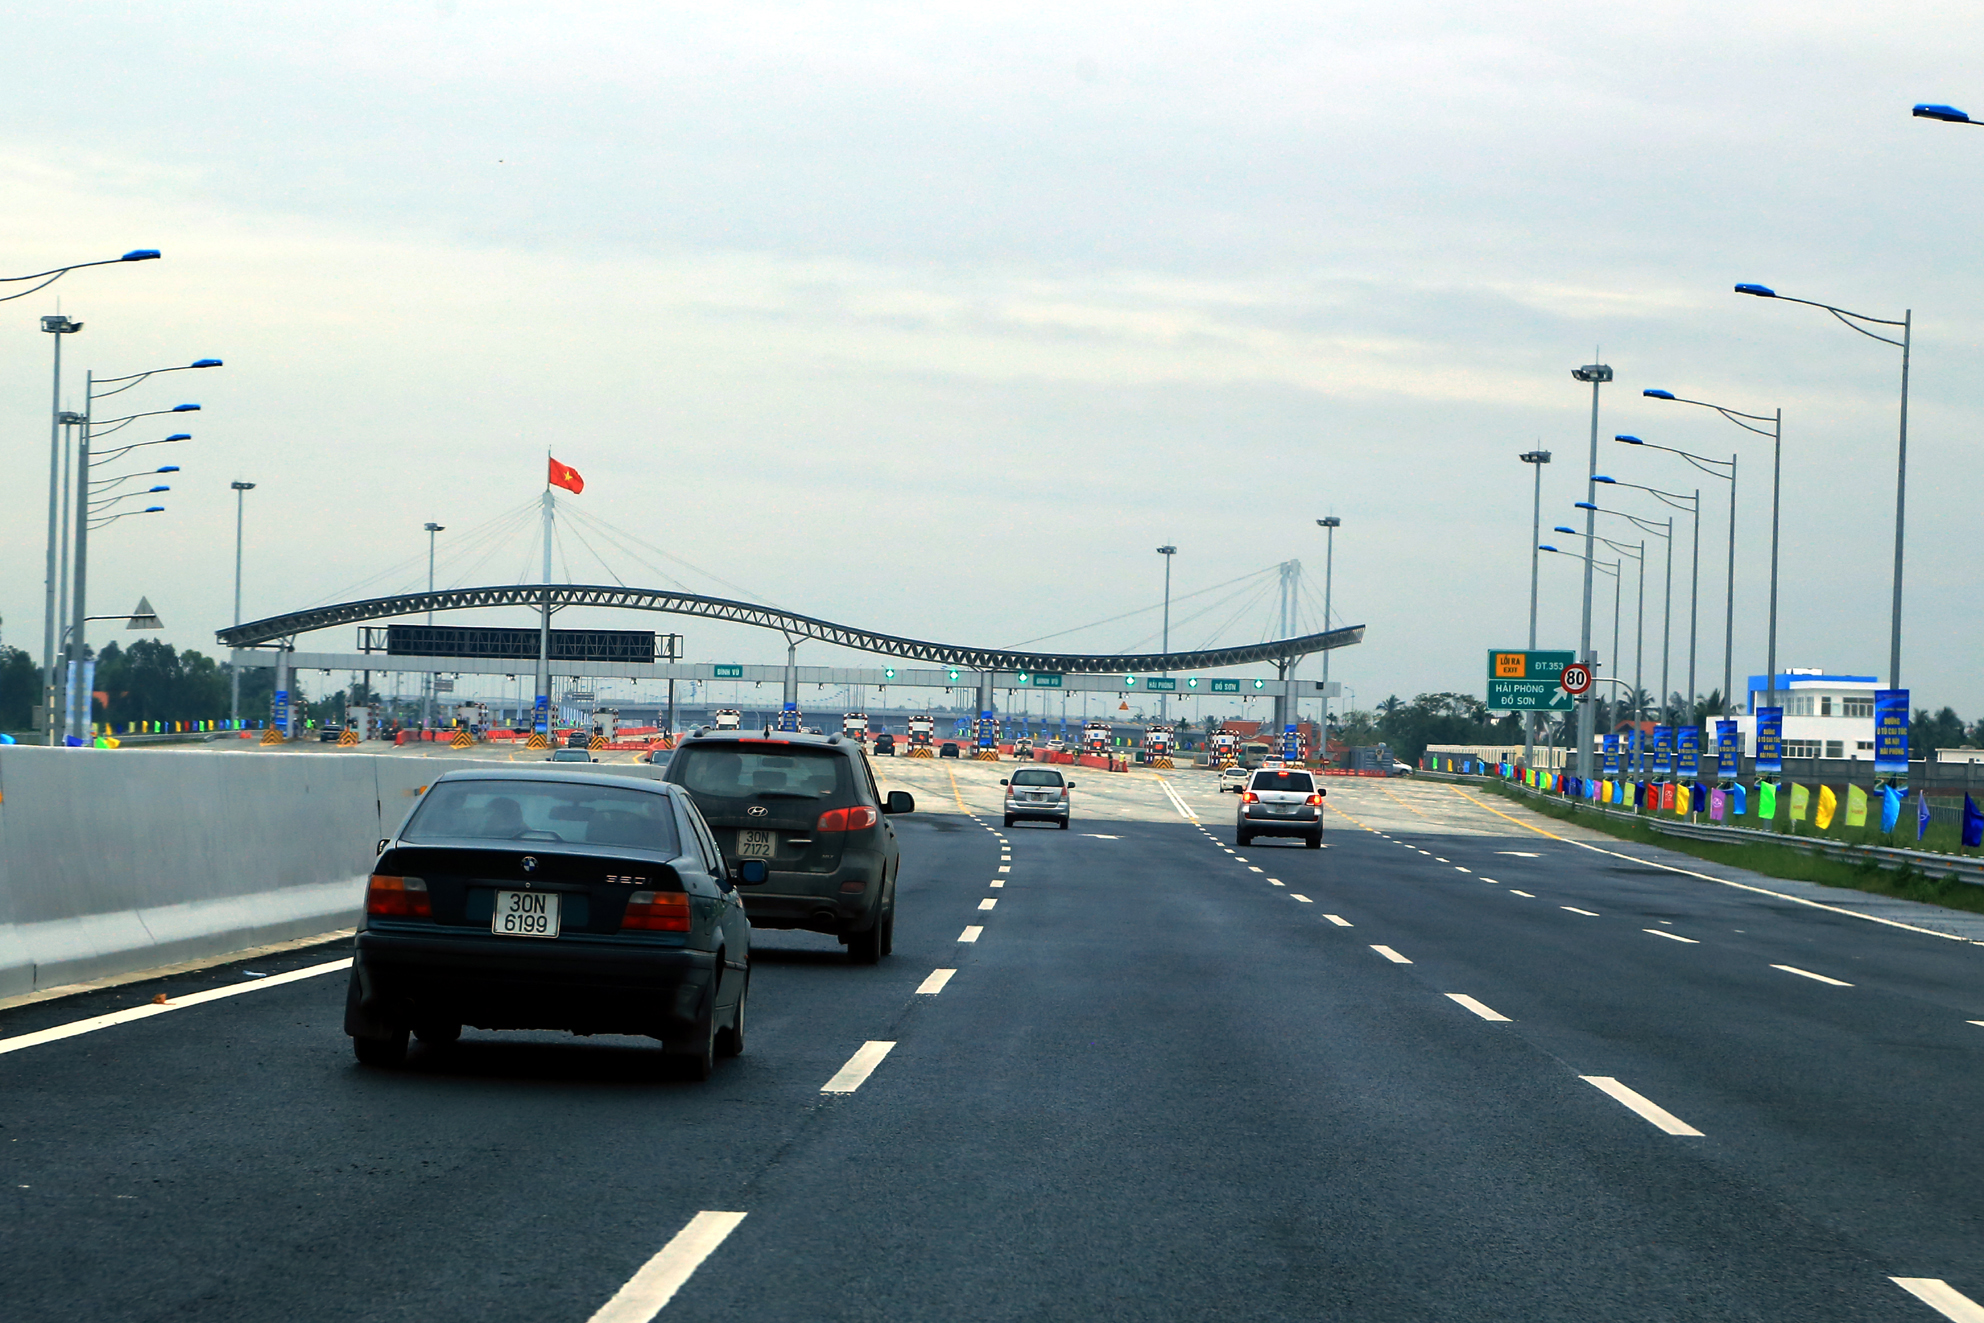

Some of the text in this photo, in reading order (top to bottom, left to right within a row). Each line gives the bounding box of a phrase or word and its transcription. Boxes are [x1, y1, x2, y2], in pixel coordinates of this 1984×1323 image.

[1535, 662, 1564, 670] ĐT.353
[1566, 671, 1585, 686] 80
[1495, 682, 1545, 693] HẢI PHÒNG
[1517, 696, 1535, 705] SƠN
[746, 831, 769, 843] 30N
[743, 842, 770, 855] 7172
[509, 893, 546, 914] 30N
[504, 914, 548, 933] 6199
